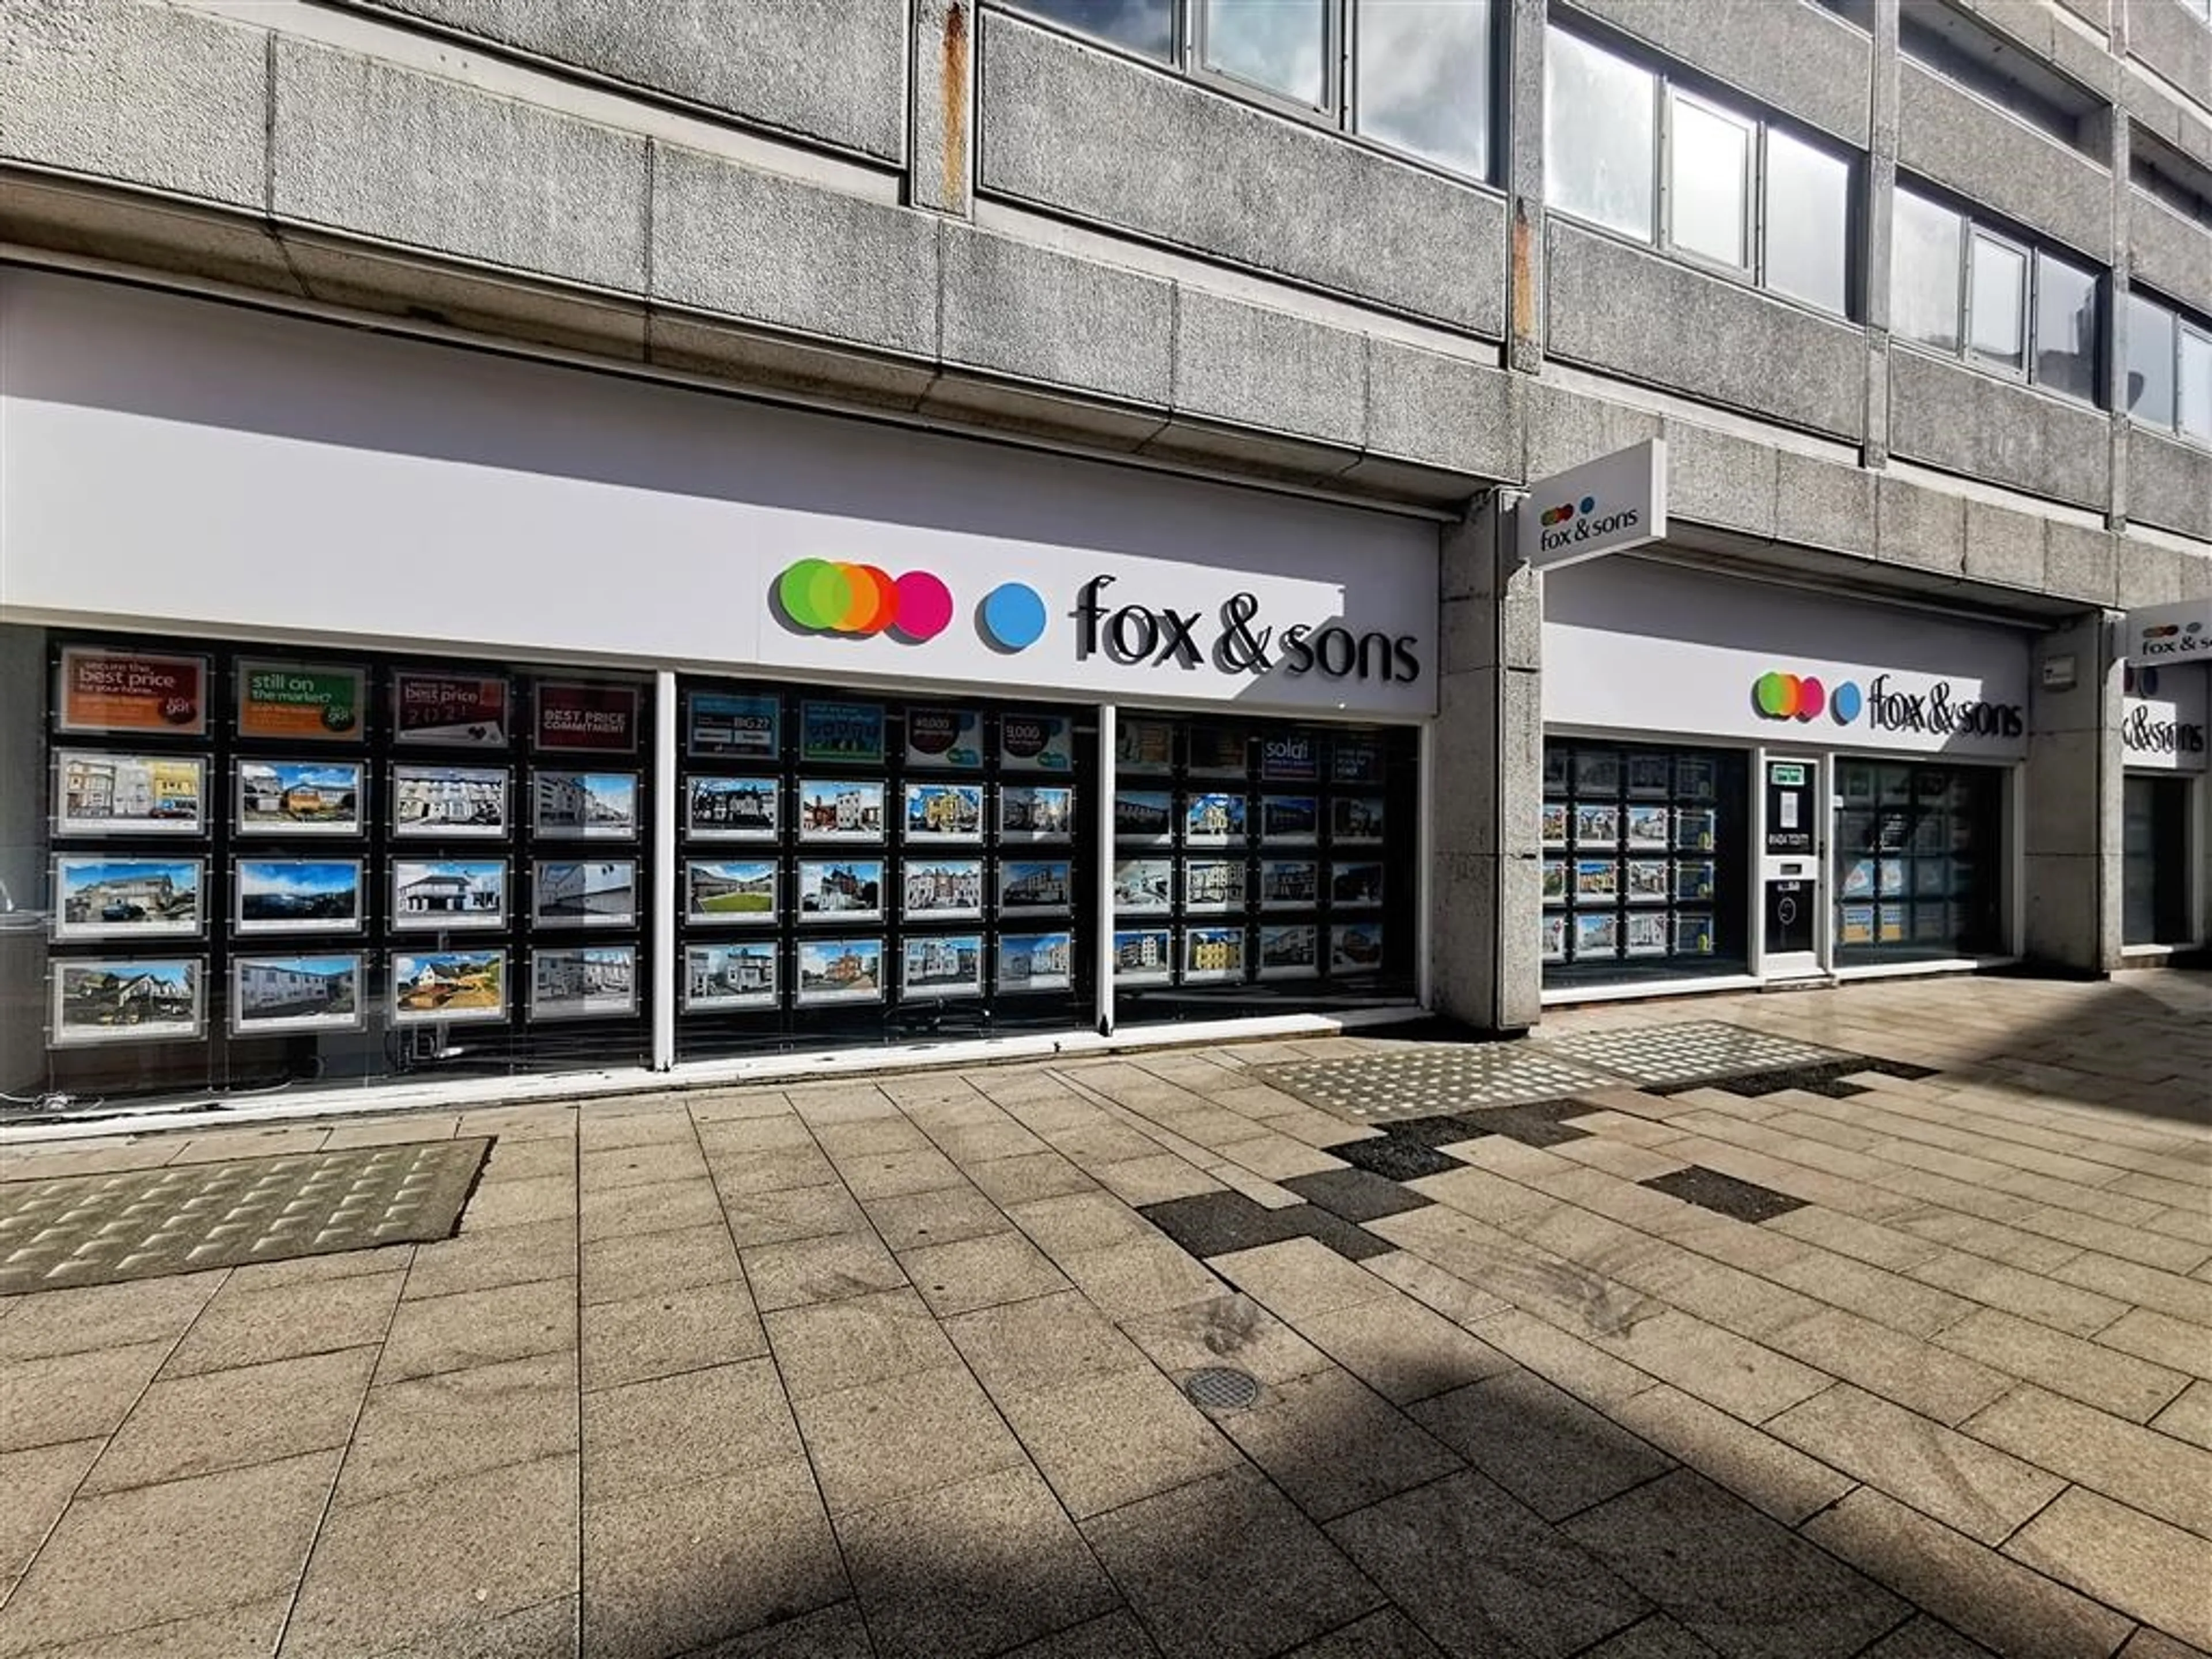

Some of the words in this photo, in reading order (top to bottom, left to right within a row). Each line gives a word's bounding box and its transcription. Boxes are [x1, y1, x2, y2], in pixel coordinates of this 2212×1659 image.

[1540, 528, 1572, 551] fox
[1574, 518, 1592, 541] &
[1592, 509, 1638, 536] sons
[1073, 574, 1205, 668] fox
[1214, 592, 1274, 674] &
[1283, 624, 1421, 684] sons
[2142, 640, 2176, 655] fox
[2180, 635, 2196, 652] &
[79, 666, 123, 684] best
[128, 671, 175, 688] price
[252, 673, 284, 689] still
[289, 678, 315, 692] on
[252, 690, 278, 700] the
[440, 688, 479, 706] price
[1869, 673, 1926, 732] fox
[1927, 681, 1959, 734] &
[1958, 700, 2024, 737] sons
[543, 721, 625, 733] COMMITMENT
[544, 709, 582, 721] BEST
[584, 711, 626, 725] PRICE
[2150, 721, 2204, 753] sons
